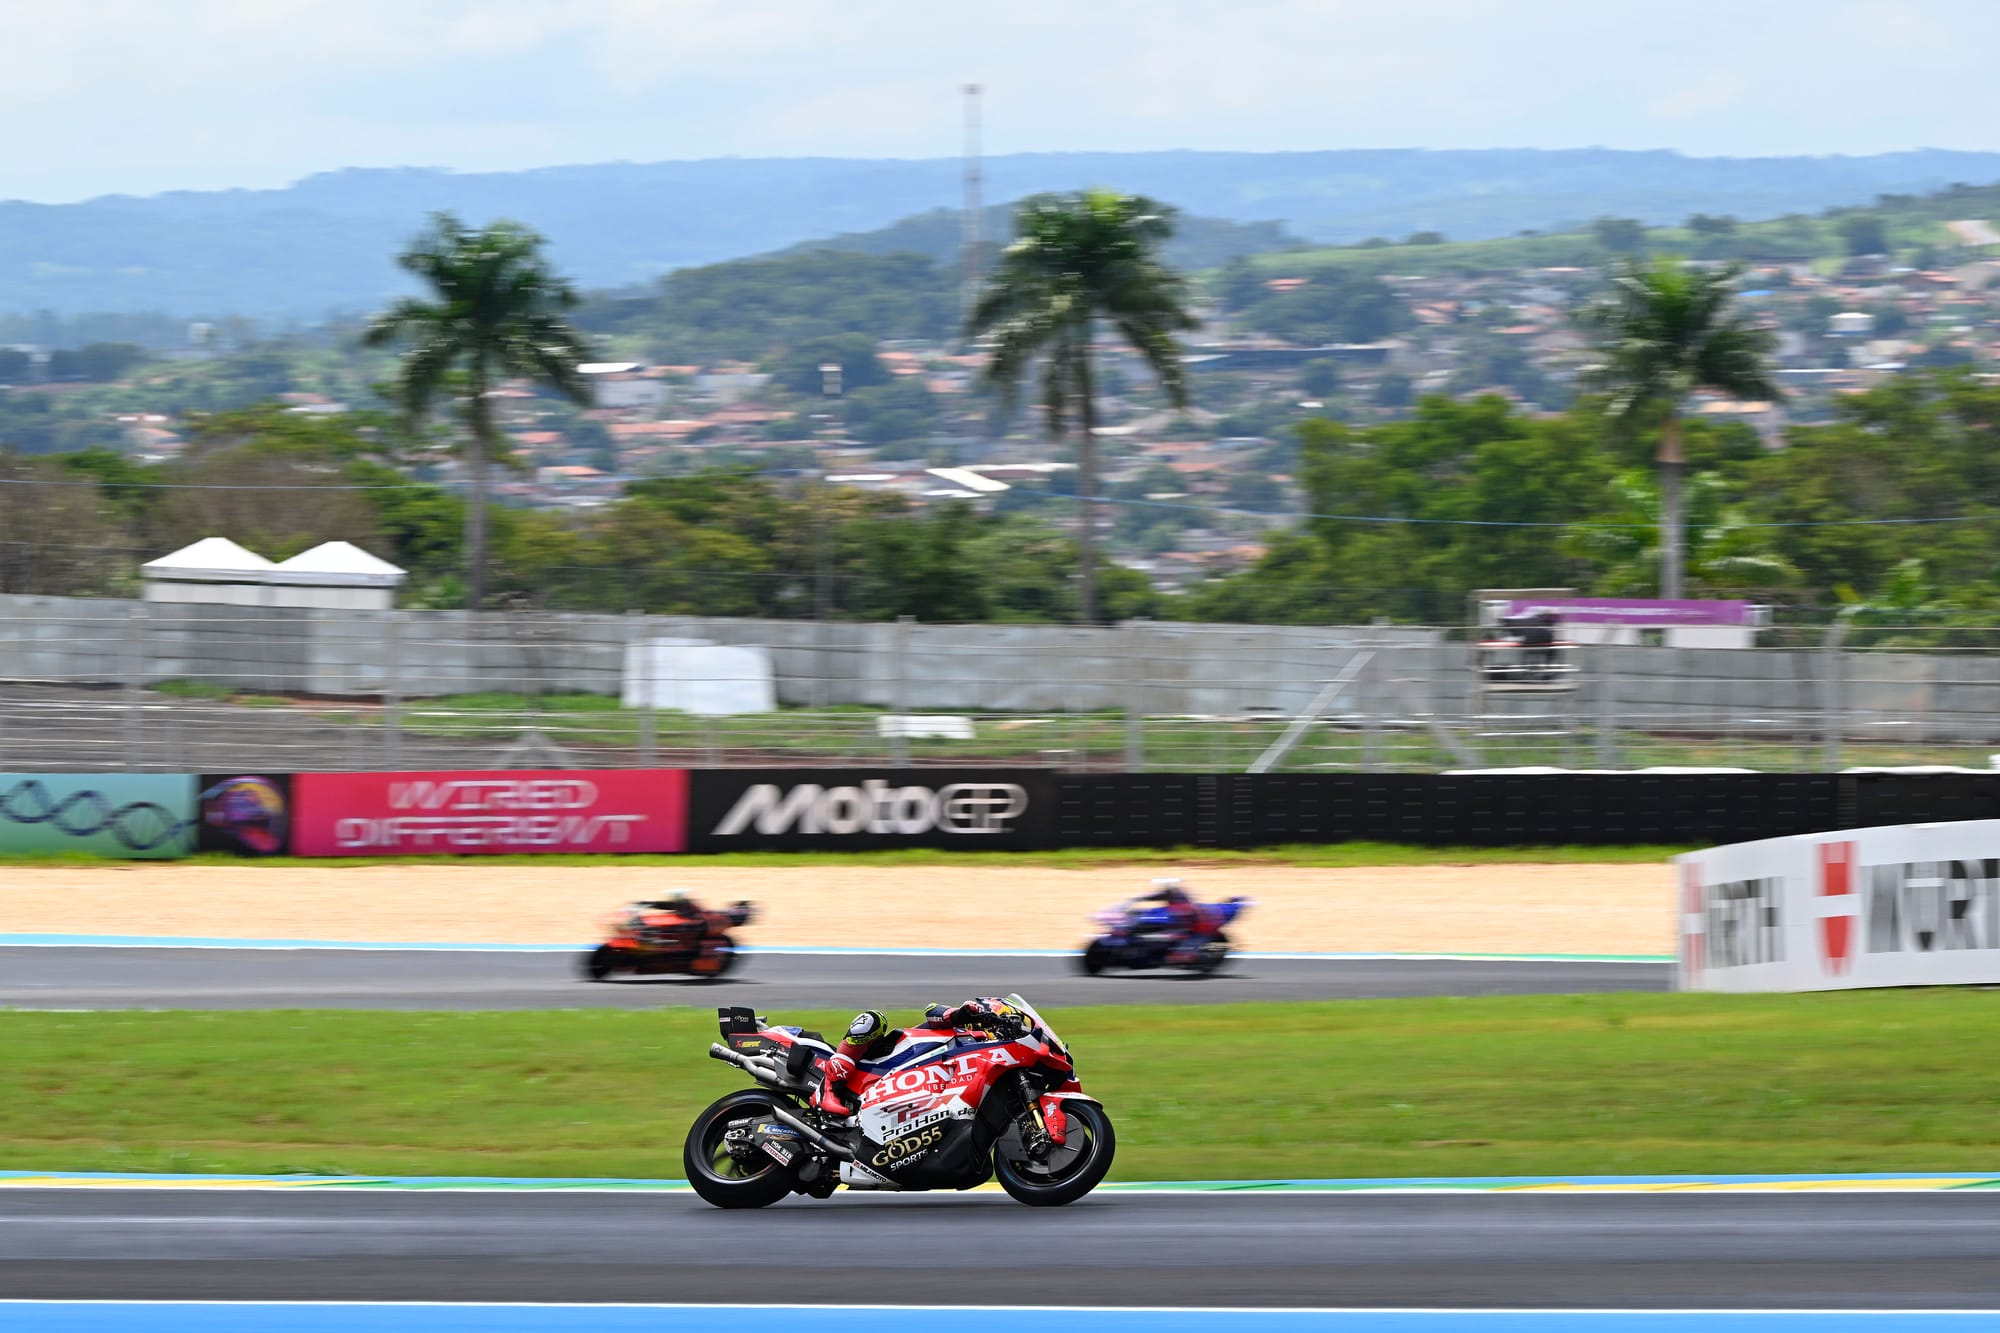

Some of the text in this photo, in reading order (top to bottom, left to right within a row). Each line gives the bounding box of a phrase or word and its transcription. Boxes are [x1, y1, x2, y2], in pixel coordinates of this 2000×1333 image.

[388, 779, 598, 810] WIRED
[710, 779, 1029, 835] MotoGP
[335, 814, 648, 847] DIFFERENT
[890, 1149, 928, 1172] SPORTS
